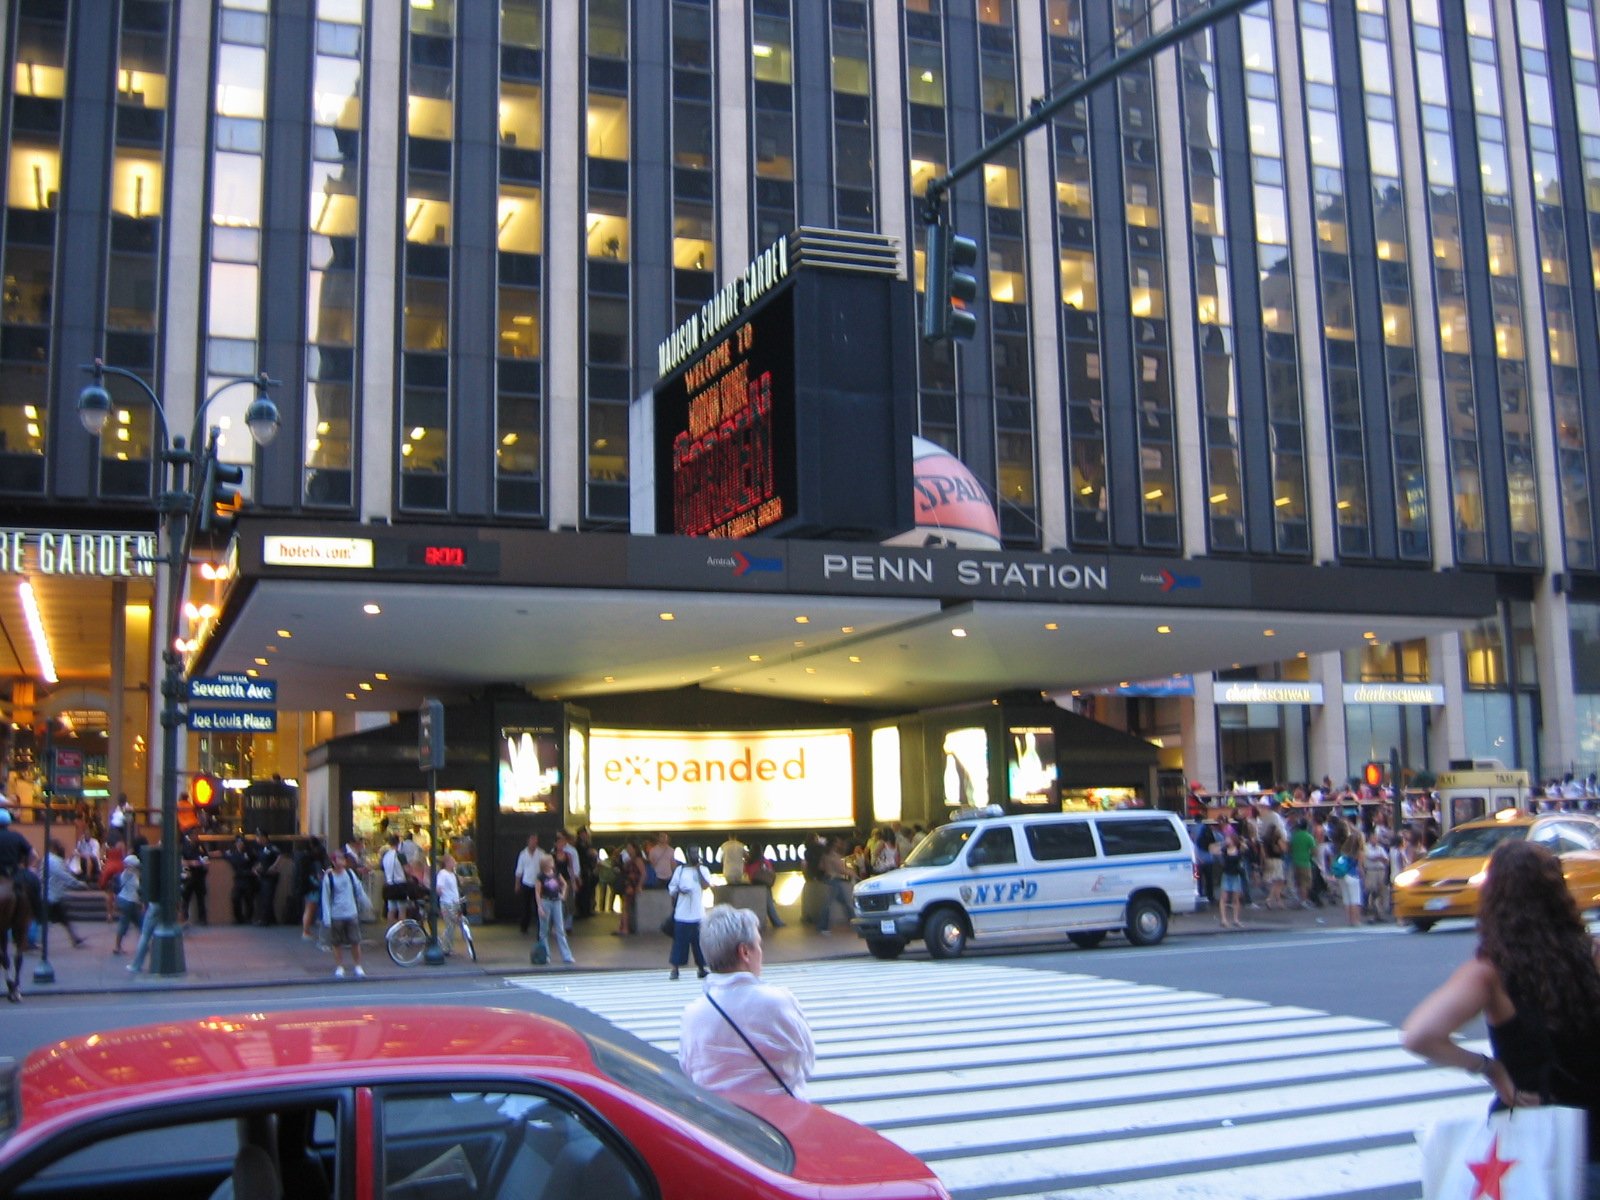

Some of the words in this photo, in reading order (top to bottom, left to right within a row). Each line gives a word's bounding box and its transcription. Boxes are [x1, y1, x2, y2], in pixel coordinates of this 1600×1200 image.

[659, 312, 699, 379] MADISON
[702, 280, 740, 342] SQUARE
[743, 234, 789, 307] GARDEN
[684, 338, 732, 395] WELCOME
[736, 321, 753, 355] TO
[40, 532, 156, 576] GARDEN
[706, 555, 736, 568] Amtrak
[823, 554, 933, 583] PENN
[957, 559, 1108, 590] STATION
[192, 680, 245, 698] Seventh
[246, 683, 272, 699] Ave
[193, 713, 212, 728] Joe
[213, 713, 242, 729] Louis
[243, 713, 273, 730] Plaza
[604, 747, 806, 791] expanded
[975, 880, 1037, 903] NYPD
